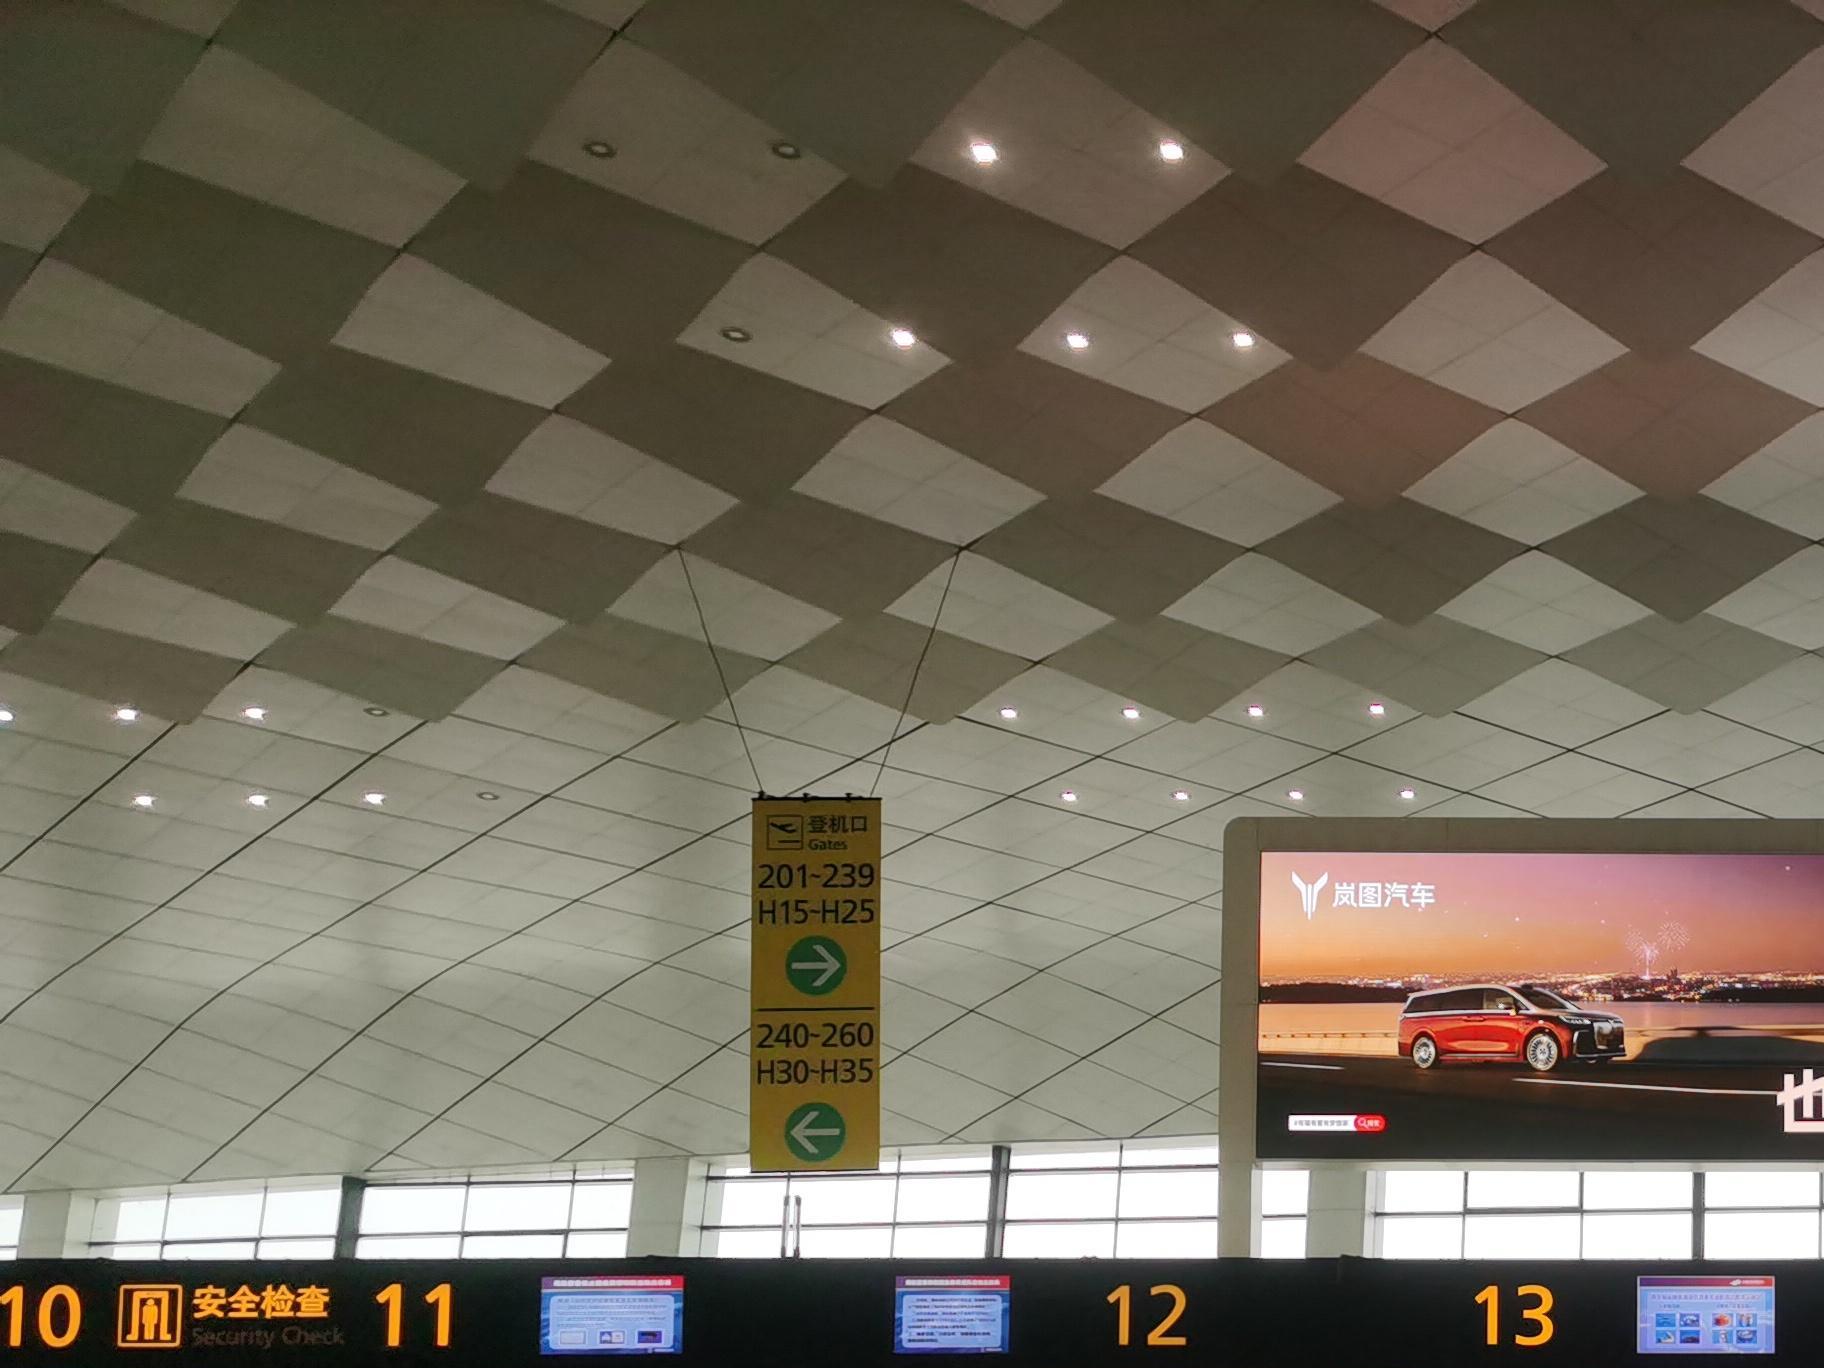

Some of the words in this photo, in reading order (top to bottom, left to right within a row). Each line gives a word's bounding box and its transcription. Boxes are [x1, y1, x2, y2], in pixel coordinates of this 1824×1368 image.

[808, 815, 868, 834] 登机口
[808, 838, 847, 851] Gates
[758, 863, 874, 889] 201~239
[1332, 882, 1436, 908] 岚图汽车
[759, 899, 874, 925] H15~H25
[756, 1023, 873, 1049] 240~260
[757, 1058, 873, 1084] H30~H35
[193, 1284, 329, 1319] 安全检查
[0, 1285, 82, 1348] 10
[375, 1283, 453, 1347] 11
[1106, 1284, 1188, 1347] 12
[1474, 1284, 1555, 1347] 13
[192, 1327, 274, 1349] Security
[282, 1325, 344, 1346] Check
